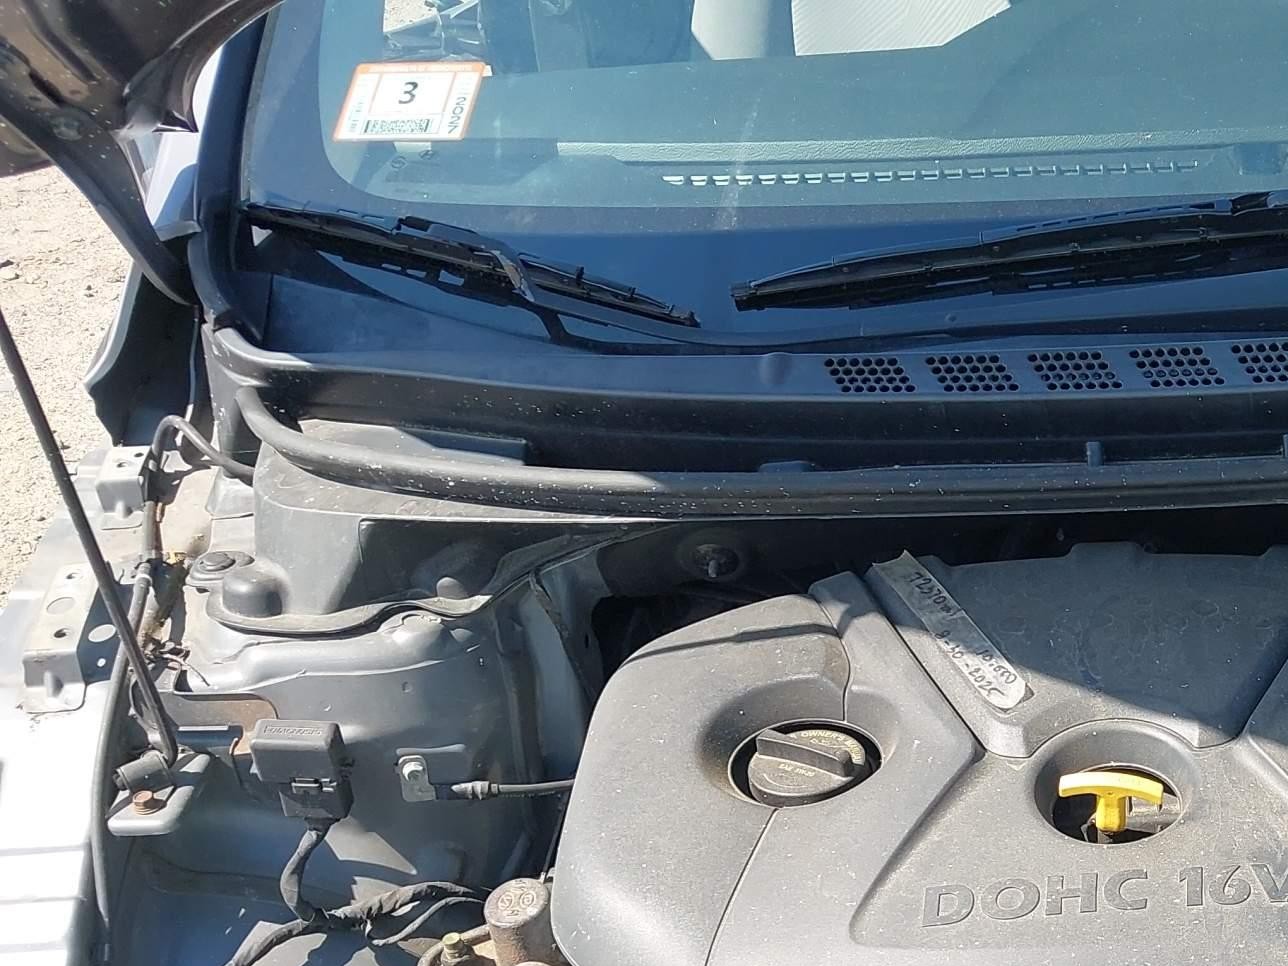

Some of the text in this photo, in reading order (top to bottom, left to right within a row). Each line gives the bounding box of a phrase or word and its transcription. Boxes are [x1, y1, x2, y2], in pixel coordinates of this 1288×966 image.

[398, 81, 418, 104] 3
[448, 97, 467, 134] 2027
[922, 867, 1149, 928] DOHC
